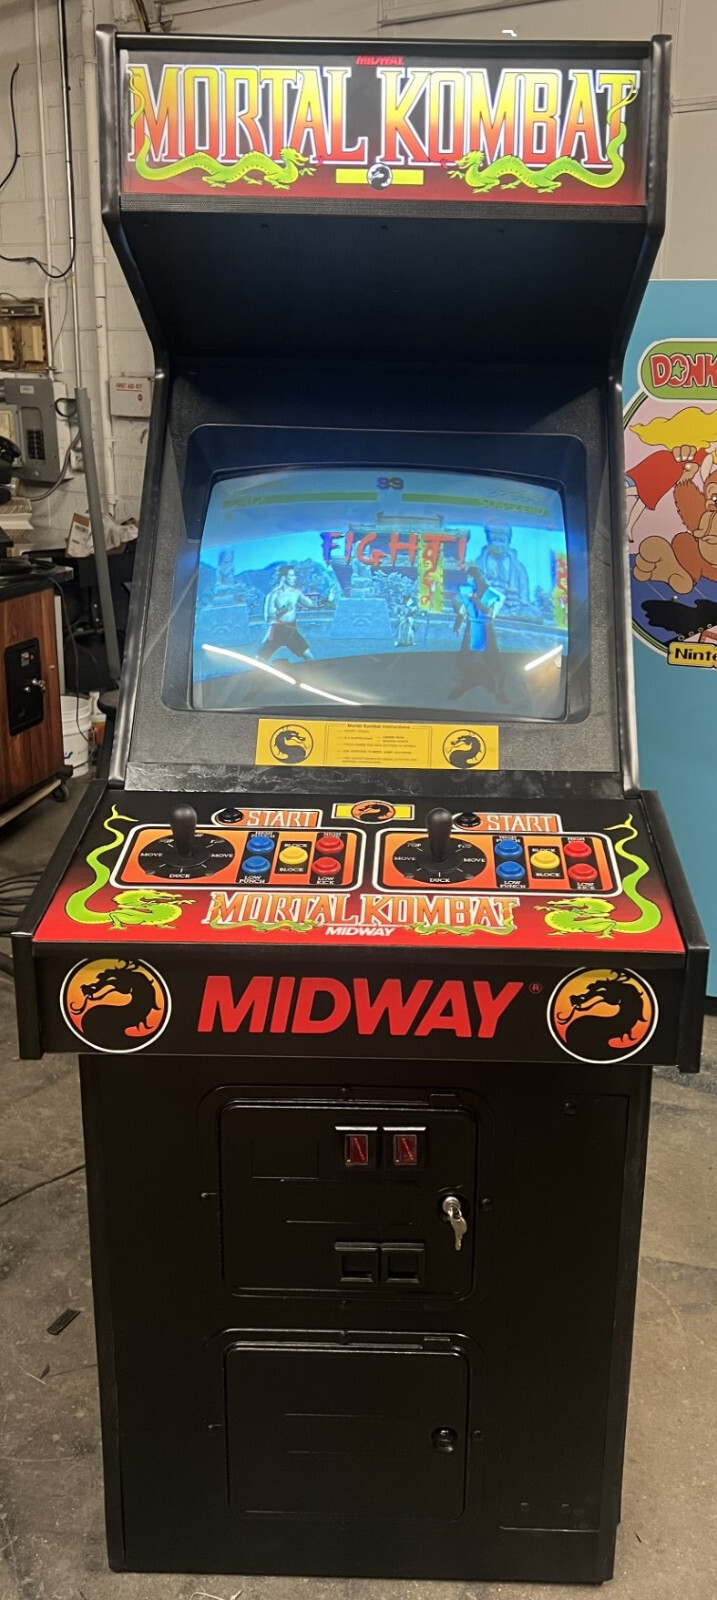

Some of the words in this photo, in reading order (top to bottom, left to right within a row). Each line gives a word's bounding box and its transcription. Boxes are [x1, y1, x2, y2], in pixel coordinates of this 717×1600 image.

[356, 55, 404, 66] MIDWAY
[128, 64, 368, 166] MORTAL
[377, 66, 640, 168] KOMBAT
[376, 477, 404, 490] 99
[320, 531, 467, 571] FIGHT!
[247, 811, 315, 828] START
[486, 814, 553, 832] START
[201, 891, 359, 926] MORTAL
[360, 893, 521, 929] KOMBAT
[325, 926, 395, 937] MIDWAY
[197, 975, 524, 1039] MIDWAY
